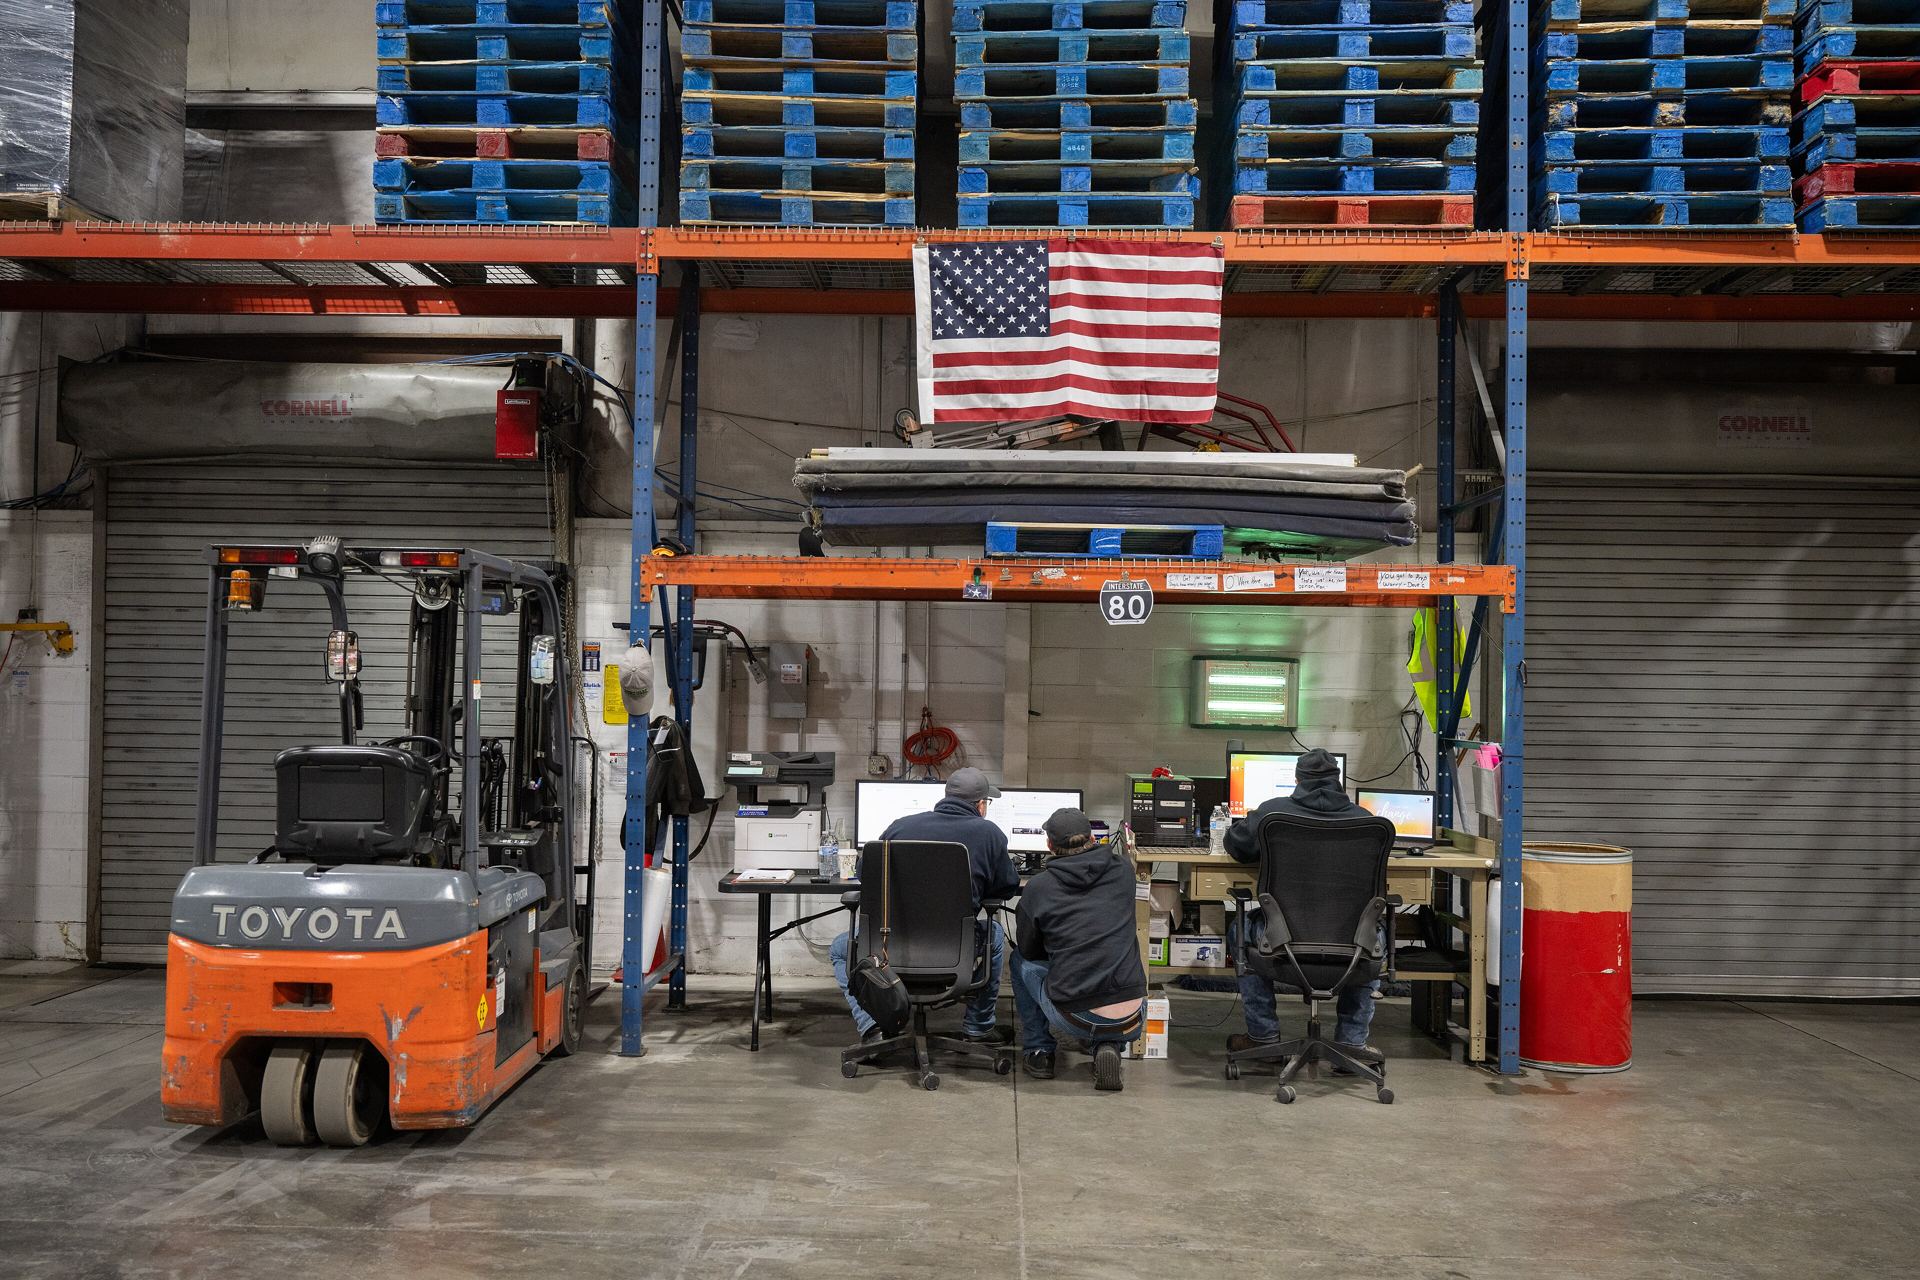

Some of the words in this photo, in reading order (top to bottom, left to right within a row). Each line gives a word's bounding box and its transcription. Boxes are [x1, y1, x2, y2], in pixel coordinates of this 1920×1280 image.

[262, 400, 352, 416] CORNELL
[1719, 416, 1810, 432] CORNELL
[1109, 595, 1145, 619] 80
[512, 887, 528, 903] TOYOTA
[211, 904, 408, 941] TOYOTA
